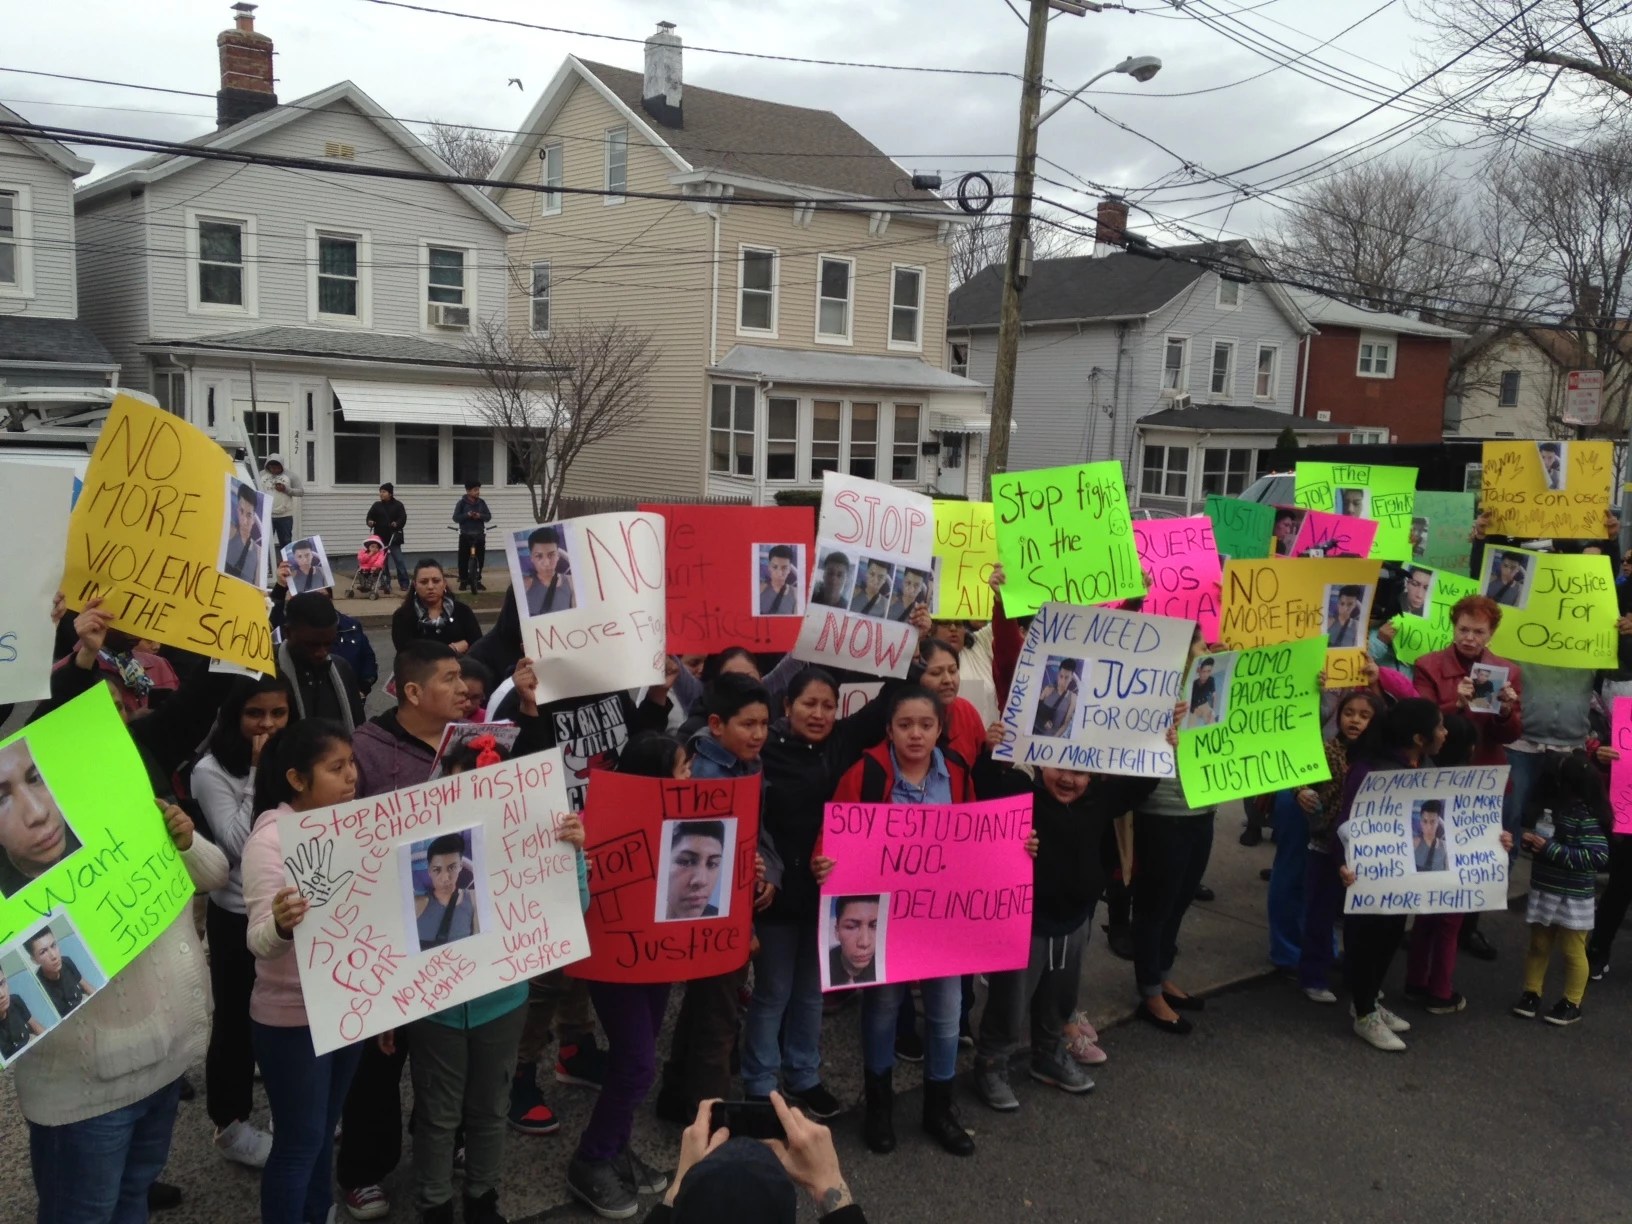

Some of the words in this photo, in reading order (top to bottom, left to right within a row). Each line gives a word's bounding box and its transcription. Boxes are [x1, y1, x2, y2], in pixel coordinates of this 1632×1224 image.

[101, 414, 182, 481] NO
[1334, 466, 1367, 482] The
[88, 481, 201, 540] MORE
[999, 480, 1063, 526] Stop
[1076, 470, 1121, 520] fights
[1534, 492, 1570, 507] con
[834, 489, 926, 554] STOP
[586, 517, 664, 601] NO
[1019, 535, 1041, 570] in
[1049, 527, 1083, 559] the
[85, 532, 230, 610] VIOLENCE
[1231, 567, 1279, 605] NO
[1438, 579, 1460, 596] We
[1535, 567, 1608, 595] Justice
[119, 591, 176, 632] THE
[187, 613, 275, 661] SCHOOL
[1223, 603, 1283, 633] MORE
[1557, 597, 1596, 623] For
[535, 620, 625, 658] More
[815, 611, 909, 671] NOW
[1043, 606, 1083, 644] WE
[1083, 613, 1161, 653] NEED
[1400, 622, 1423, 651] NO
[1093, 658, 1185, 700] JUSTICE
[1234, 648, 1292, 678] COMO
[1004, 673, 1031, 728] MORE
[1230, 674, 1310, 711] PADRES...
[1082, 704, 1121, 731] FOR
[1125, 707, 1174, 734] OSCAR
[996, 730, 1017, 758] NO
[1024, 741, 1054, 763] NO
[1058, 745, 1104, 769] MORE
[1108, 747, 1174, 775] FIGHTS
[1195, 726, 1235, 759] MOS
[665, 786, 729, 815] The
[1360, 775, 1387, 796] NO
[1384, 772, 1432, 794] MORE
[1434, 769, 1499, 790] FIGHTS
[299, 807, 370, 839] Stop
[374, 792, 402, 822] All
[470, 776, 494, 800] in
[503, 796, 527, 829] All
[1378, 795, 1403, 817] the
[1453, 794, 1471, 812] NO
[1473, 794, 1504, 809] MORE
[830, 804, 877, 839] SOY
[885, 807, 1033, 843] ESTUDIANTE
[1455, 823, 1488, 847] STOP
[880, 844, 947, 876] NOO.
[1353, 844, 1373, 861] NO
[1455, 853, 1470, 868] NO
[24, 828, 130, 917] Want
[490, 853, 575, 897] Justice
[308, 846, 390, 969] JUSTICE
[495, 893, 542, 931] We
[1351, 893, 1379, 910] NO
[1380, 890, 1422, 909] MORE
[1427, 889, 1486, 910] FIGHTS
[491, 939, 571, 983] Justice
[604, 926, 741, 969] Justice
[339, 944, 407, 1042] OSCAR
[391, 987, 415, 1017] NO
[414, 947, 462, 995] MORE
